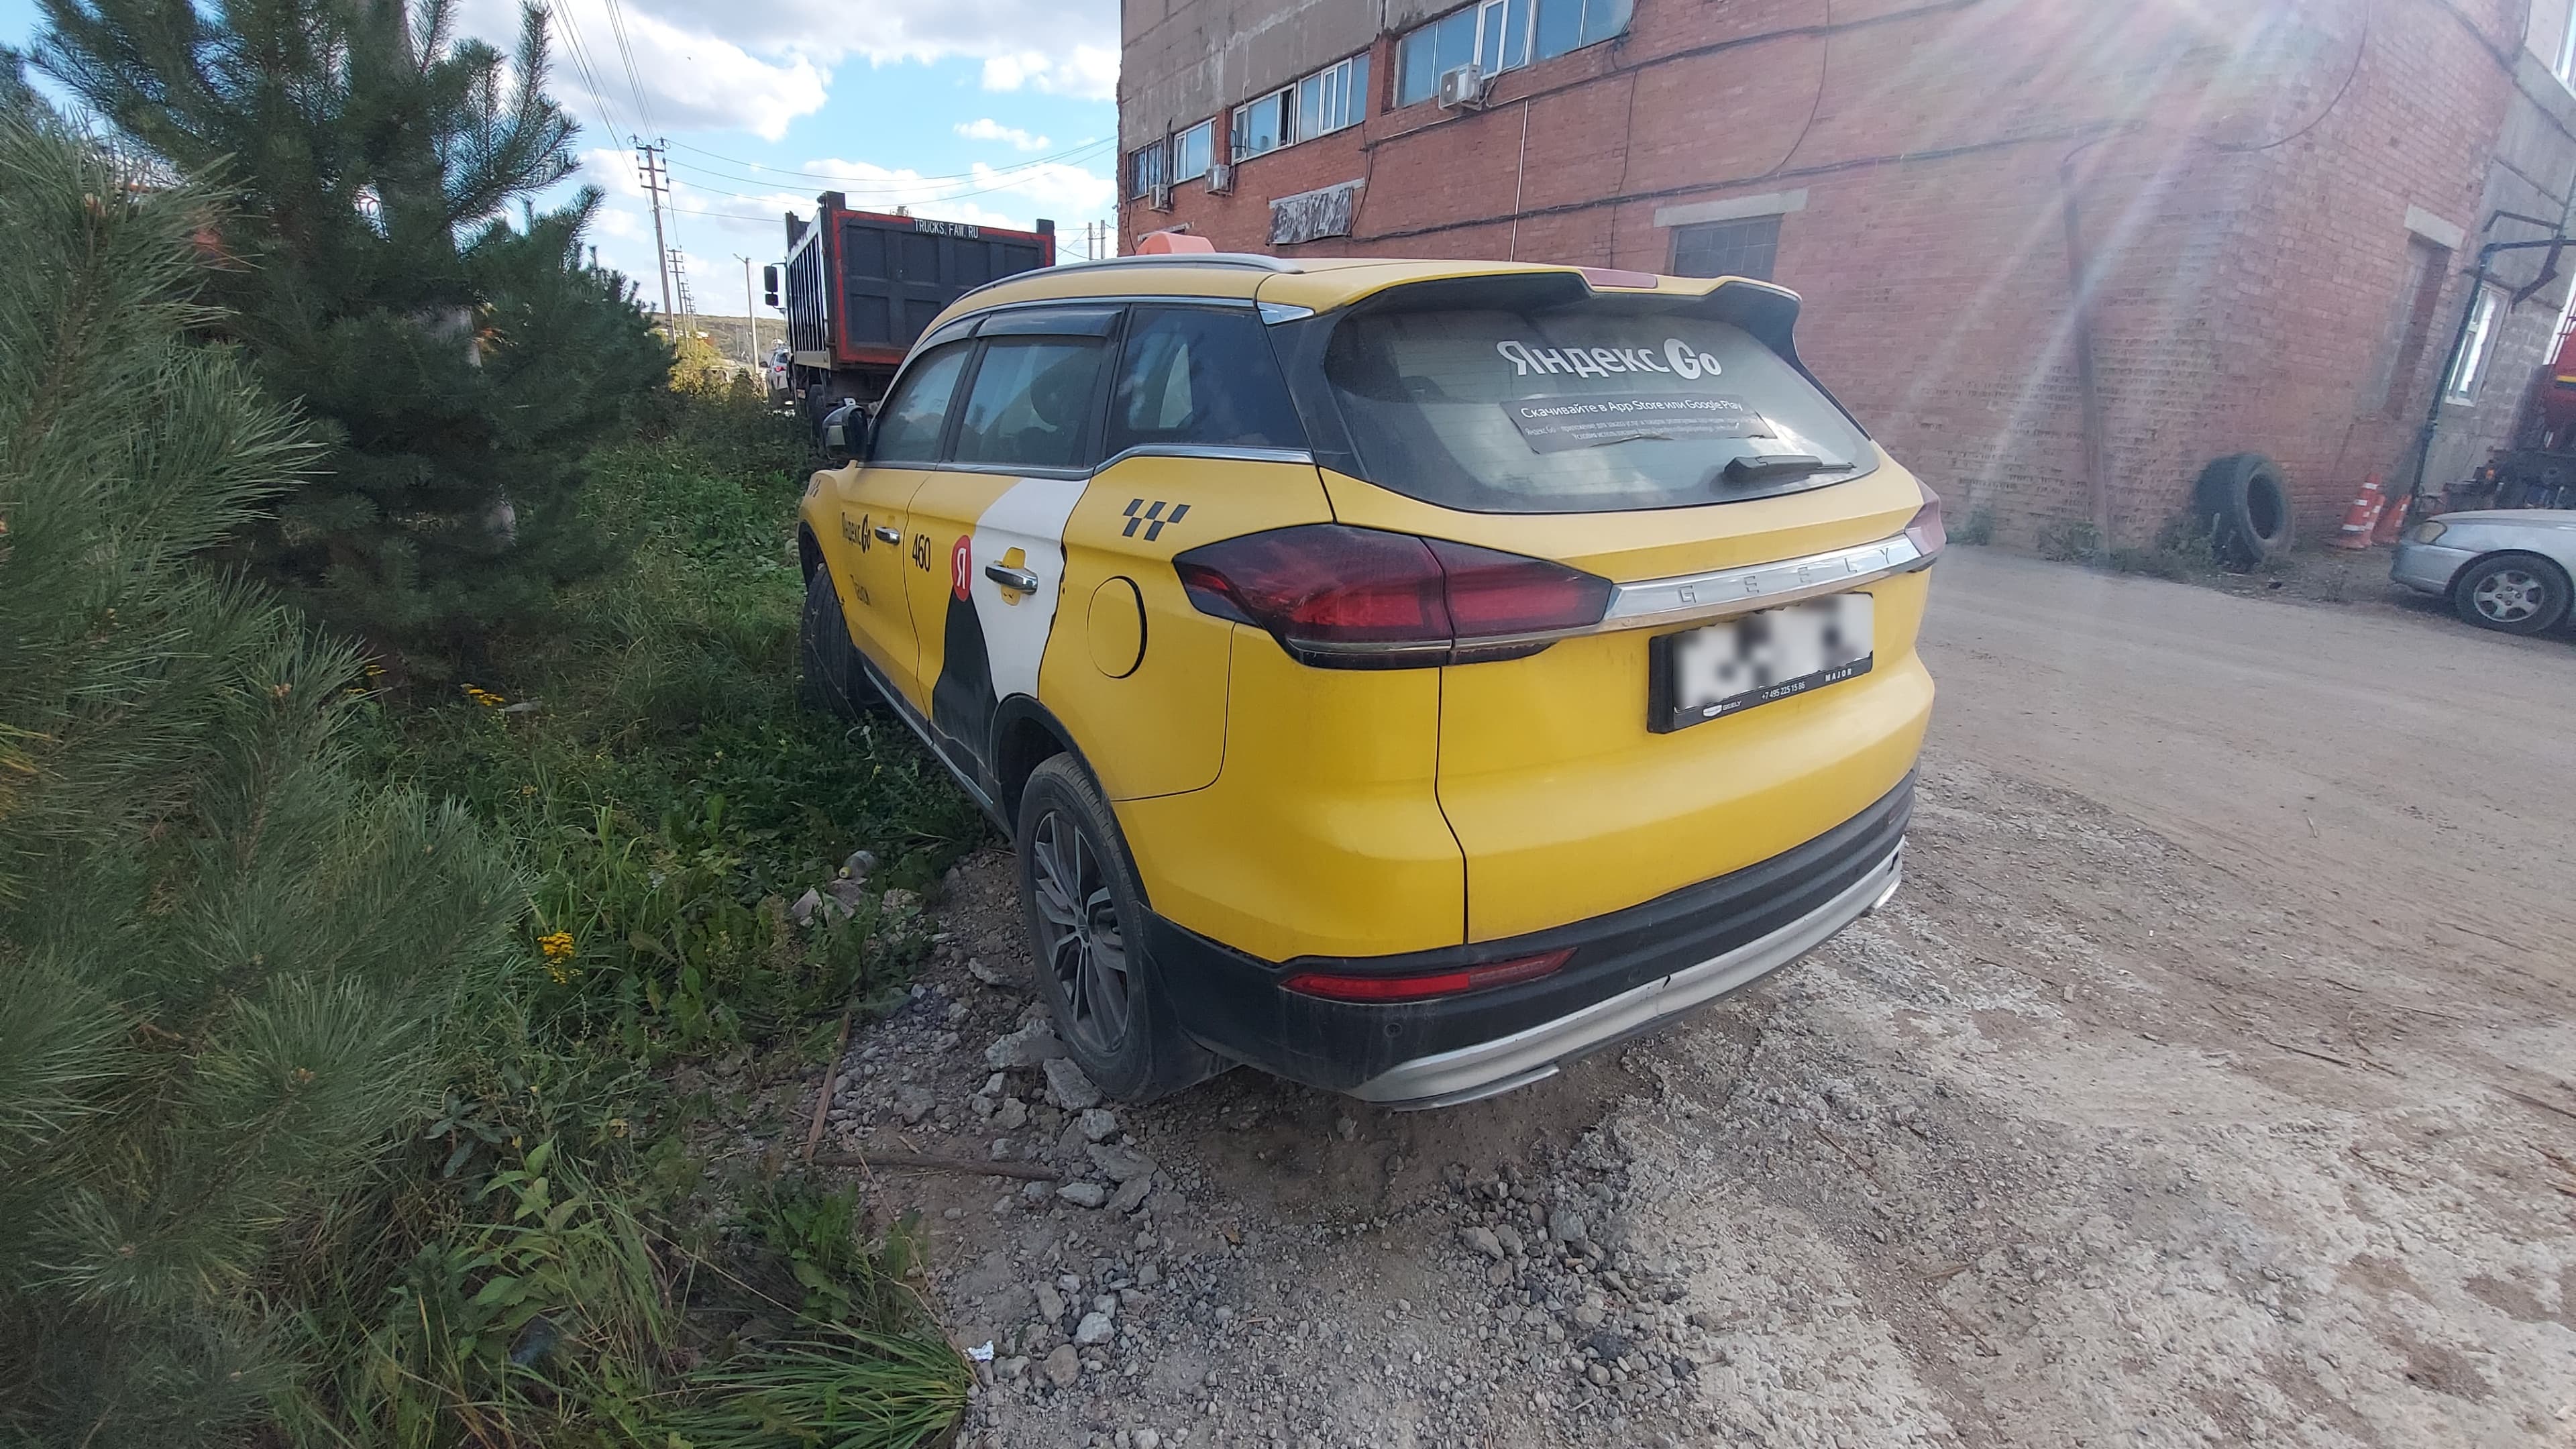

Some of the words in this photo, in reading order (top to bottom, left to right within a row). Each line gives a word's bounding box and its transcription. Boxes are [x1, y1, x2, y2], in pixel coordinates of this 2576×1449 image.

[1497, 340, 1670, 378] Яндекс
[1664, 338, 1721, 380] Go
[1521, 403, 1598, 418] Скачивайте
[1598, 404, 1607, 412] в
[1608, 401, 1633, 413] App
[1632, 400, 1665, 411] Store
[1666, 401, 1686, 409] или
[1684, 399, 1723, 411] Google
[1719, 400, 1743, 411] Play
[912, 533, 930, 572] 460
[957, 547, 967, 590] Я
[1825, 668, 1851, 682] MAJOR
[1762, 692, 1769, 700] +7
[1769, 688, 1780, 698] 495
[1780, 686, 1790, 695] 225
[1791, 683, 1798, 692] 15
[1722, 700, 1742, 711] GEELY
